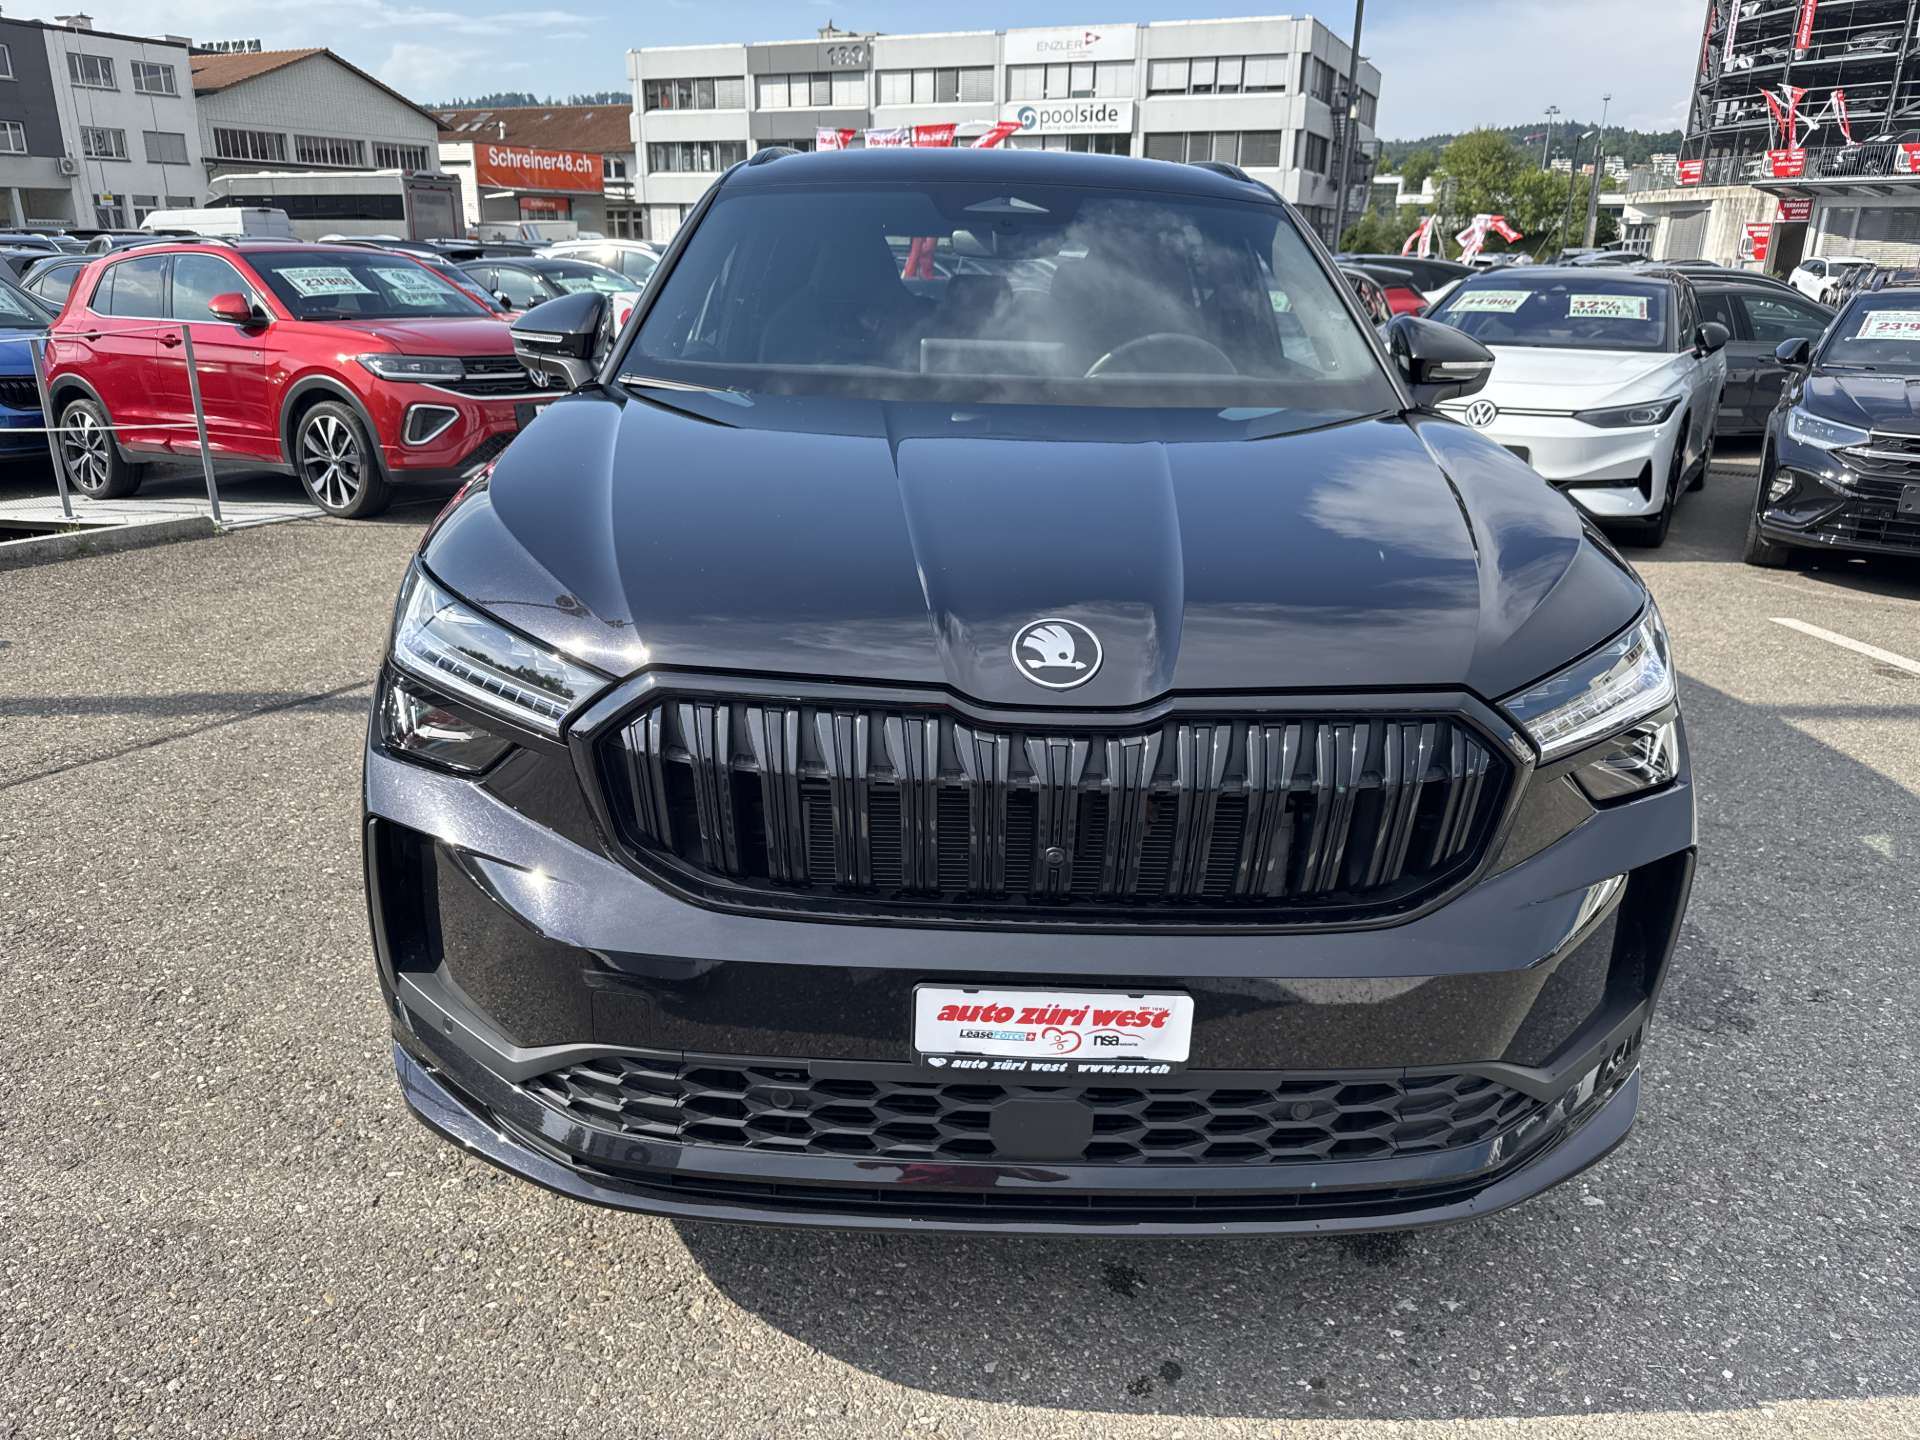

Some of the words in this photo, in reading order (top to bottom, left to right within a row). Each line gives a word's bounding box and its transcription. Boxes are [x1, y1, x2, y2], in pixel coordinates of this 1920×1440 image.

[1036, 39, 1083, 52] ENZLER
[1040, 103, 1119, 130] poolside
[488, 146, 593, 174] Schreiner48.ch
[1572, 308, 1621, 316] RABATT
[937, 1002, 1015, 1024] auto
[1015, 1003, 1091, 1026] züri
[1092, 1008, 1171, 1029] west
[959, 1028, 1025, 1042] LeaseForce
[1094, 1035, 1120, 1046] nsa
[951, 1058, 989, 1069] auto
[991, 1059, 1028, 1072] züri
[1031, 1061, 1069, 1073] west
